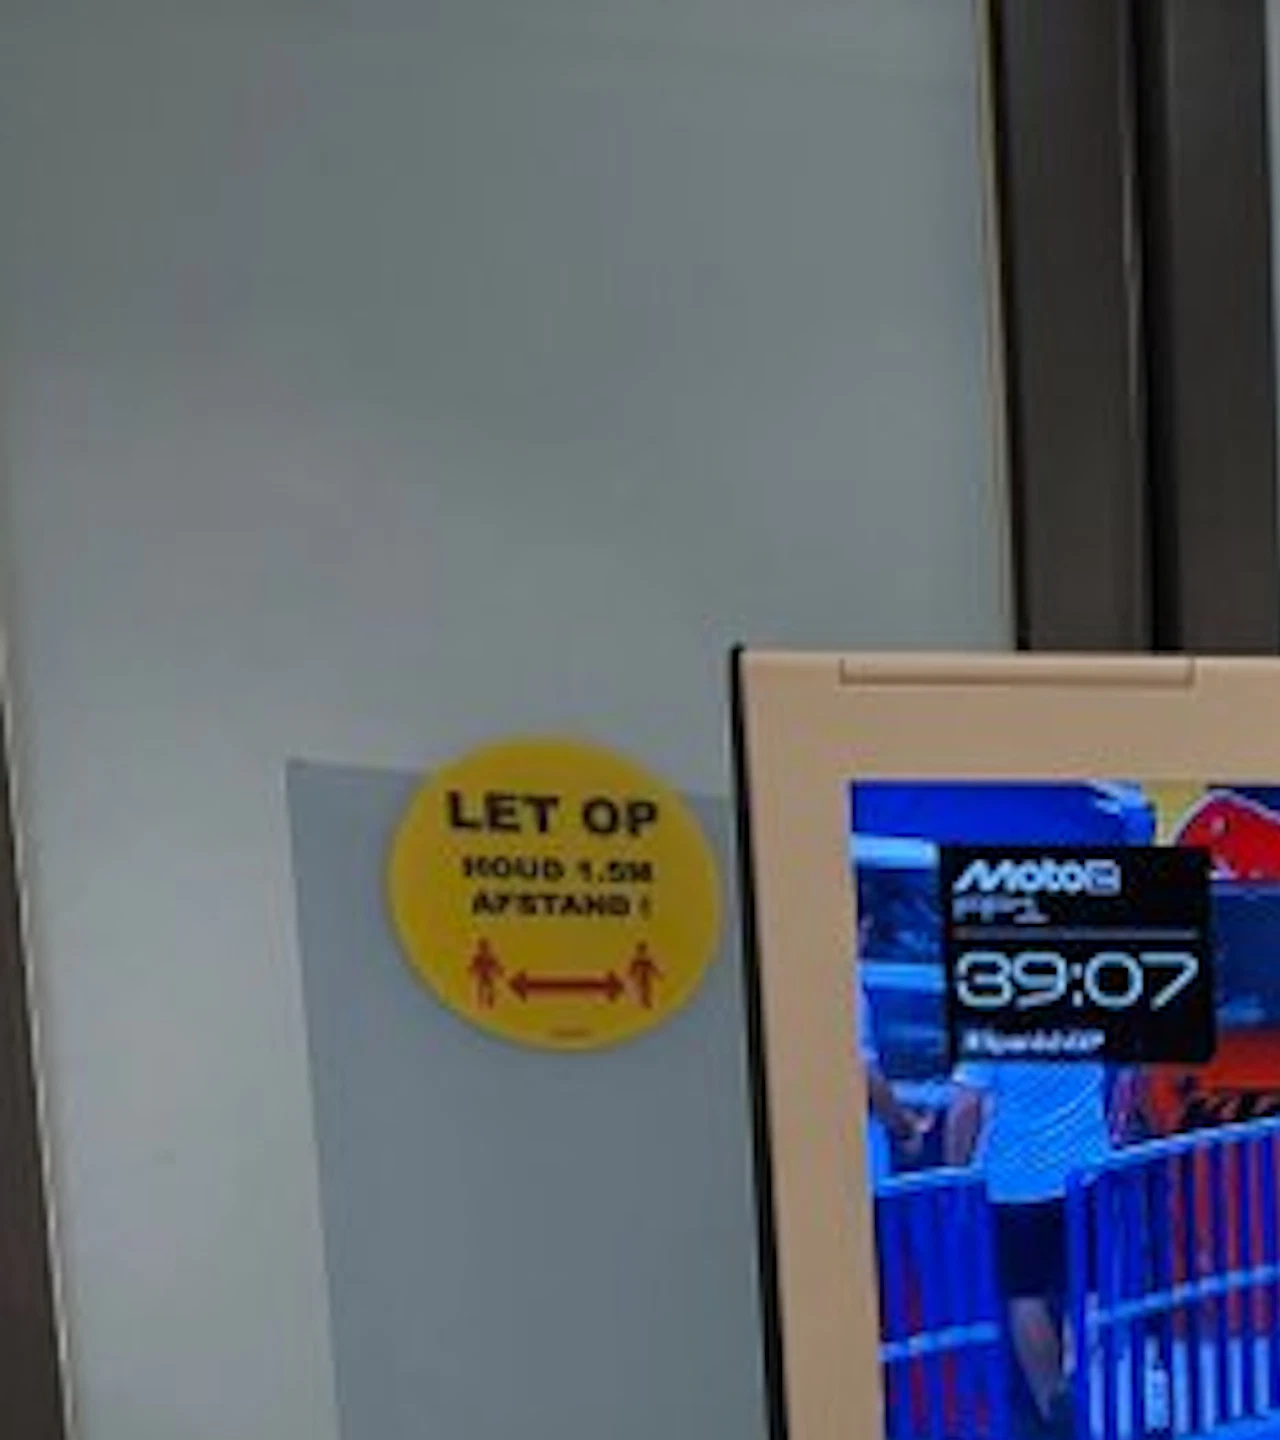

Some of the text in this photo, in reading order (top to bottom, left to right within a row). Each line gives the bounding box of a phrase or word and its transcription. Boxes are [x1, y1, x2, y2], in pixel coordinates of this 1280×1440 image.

[446, 790, 659, 837] LET OP
[461, 856, 565, 882] HOUD
[471, 891, 631, 917] AFSTAND
[956, 951, 1200, 1009] 39:07
